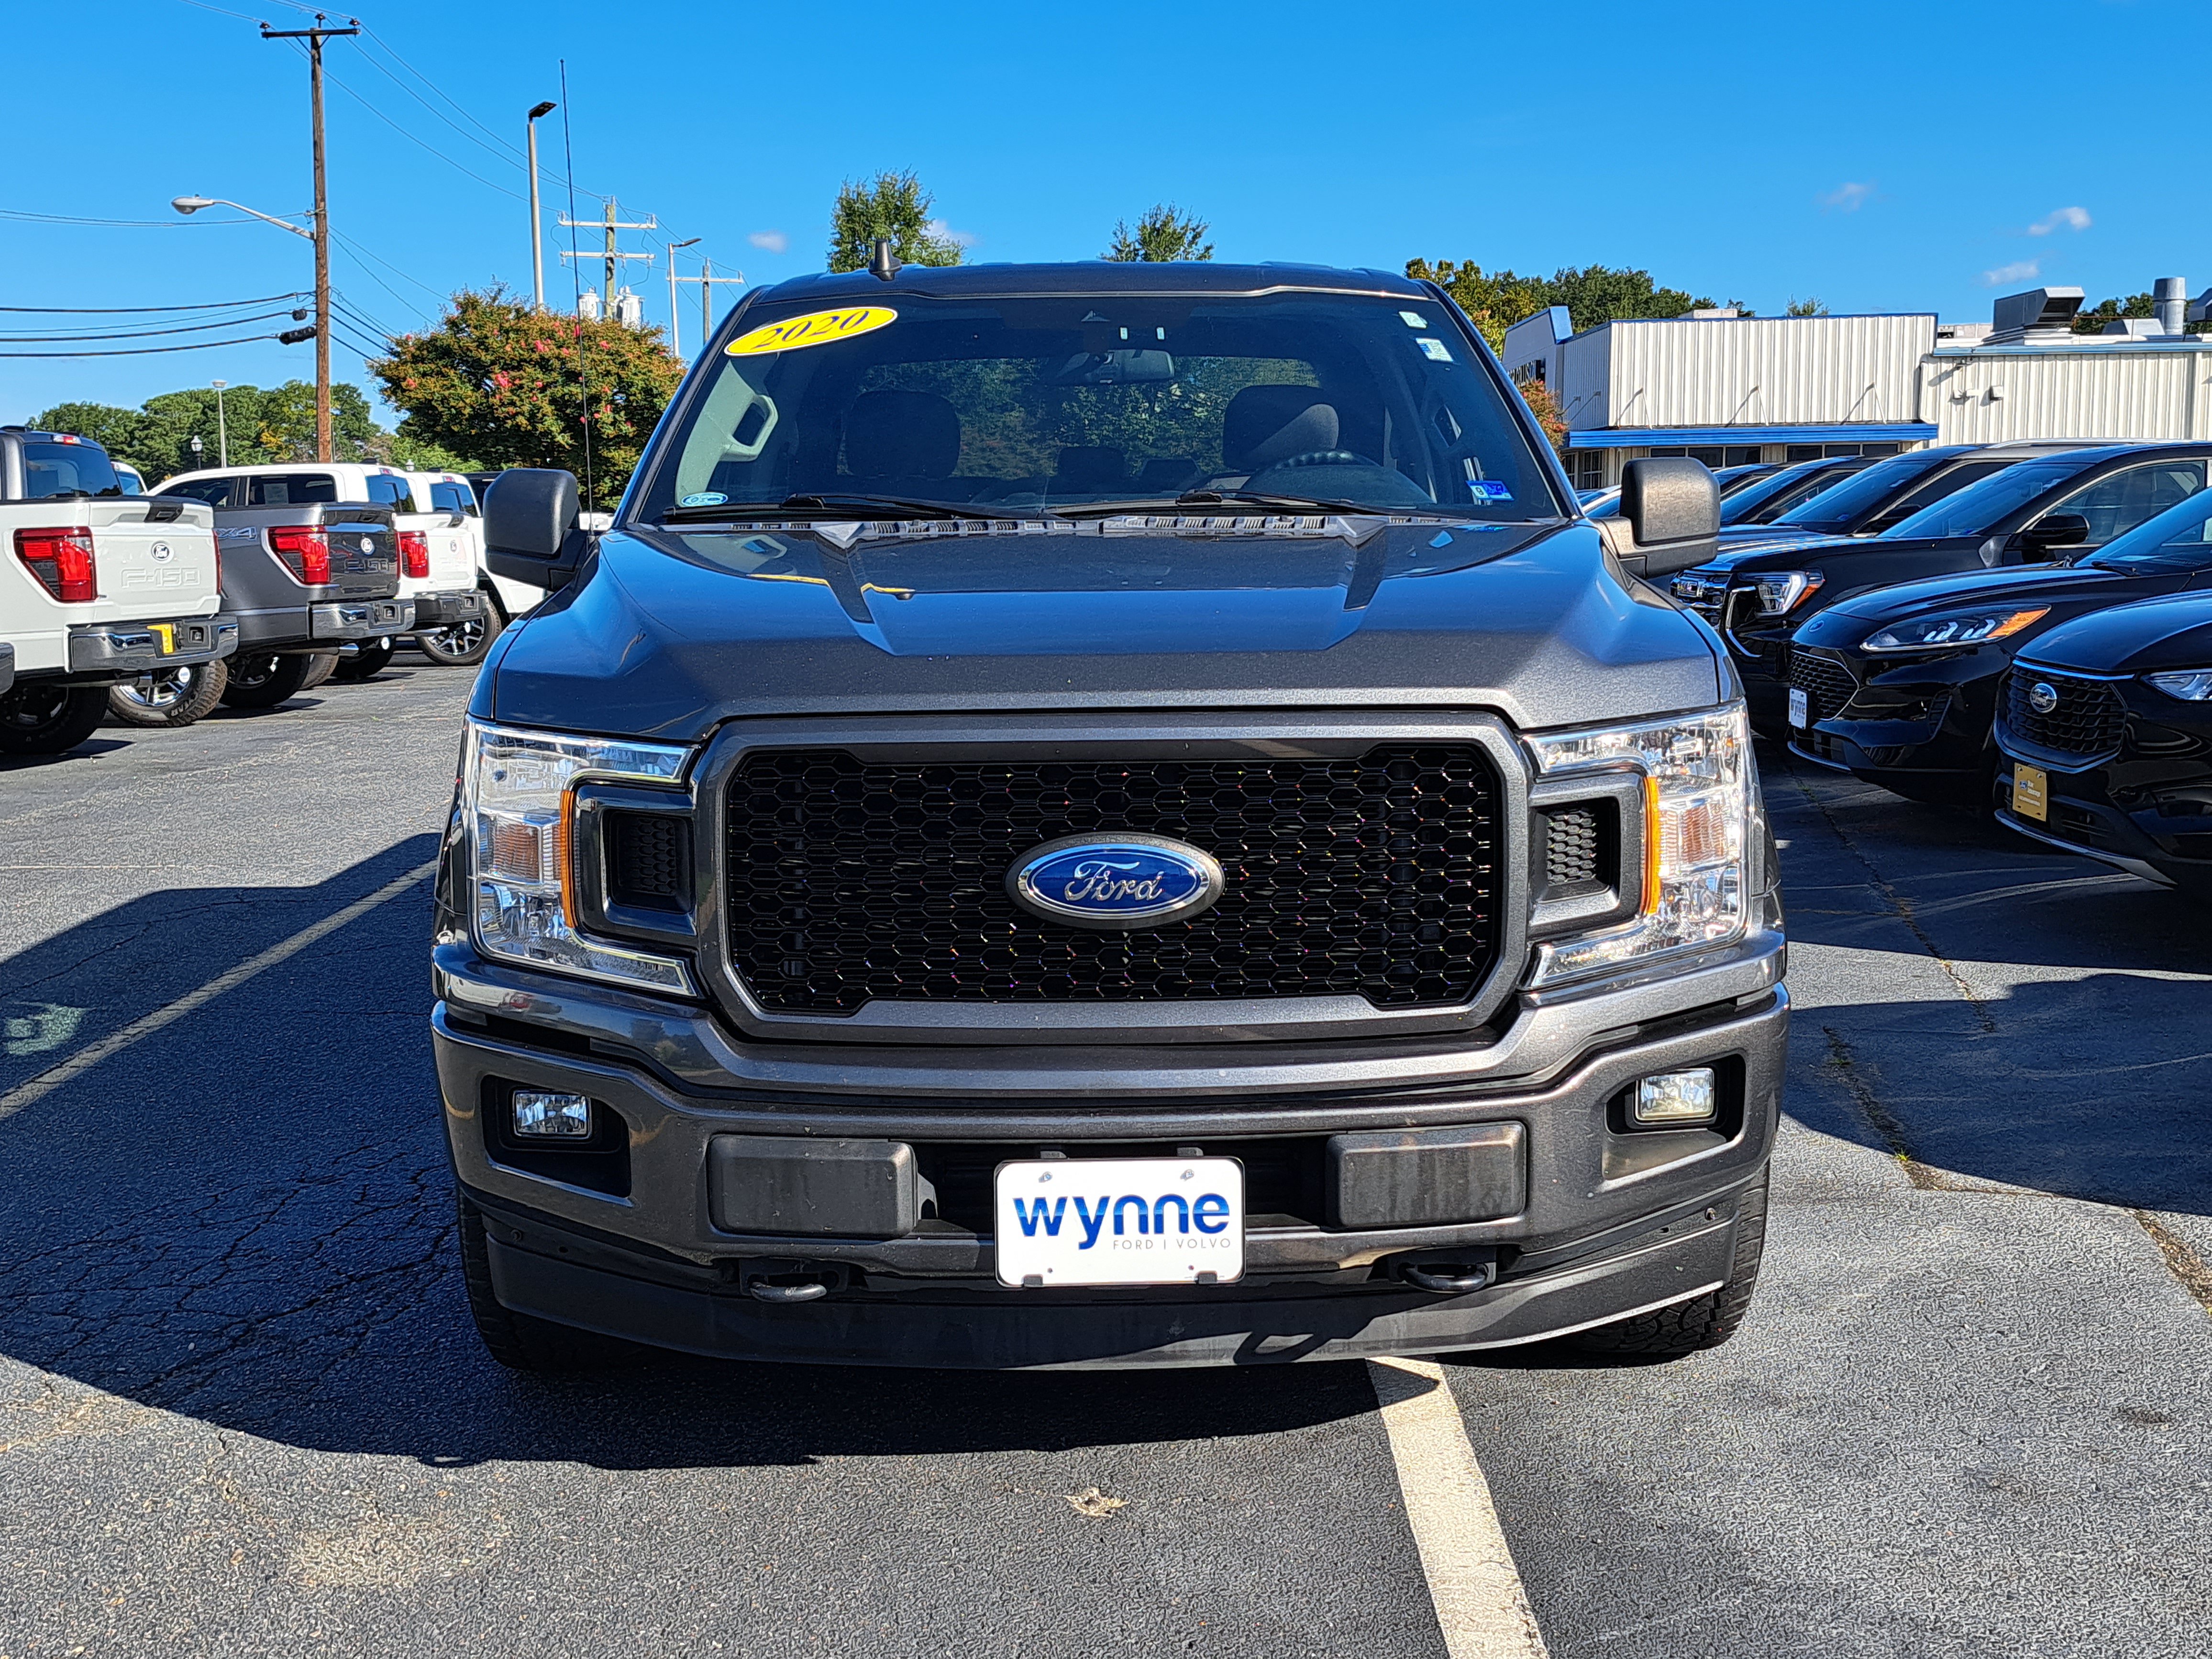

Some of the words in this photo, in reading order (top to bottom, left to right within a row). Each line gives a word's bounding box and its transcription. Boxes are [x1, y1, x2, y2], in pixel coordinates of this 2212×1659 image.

[750, 310, 869, 350] 2020
[121, 567, 200, 588] F-150
[1064, 861, 1164, 901] Ford
[1013, 1193, 1230, 1250] wynne
[1113, 1239, 1153, 1250] FORD
[1176, 1238, 1231, 1249] VOLVO
